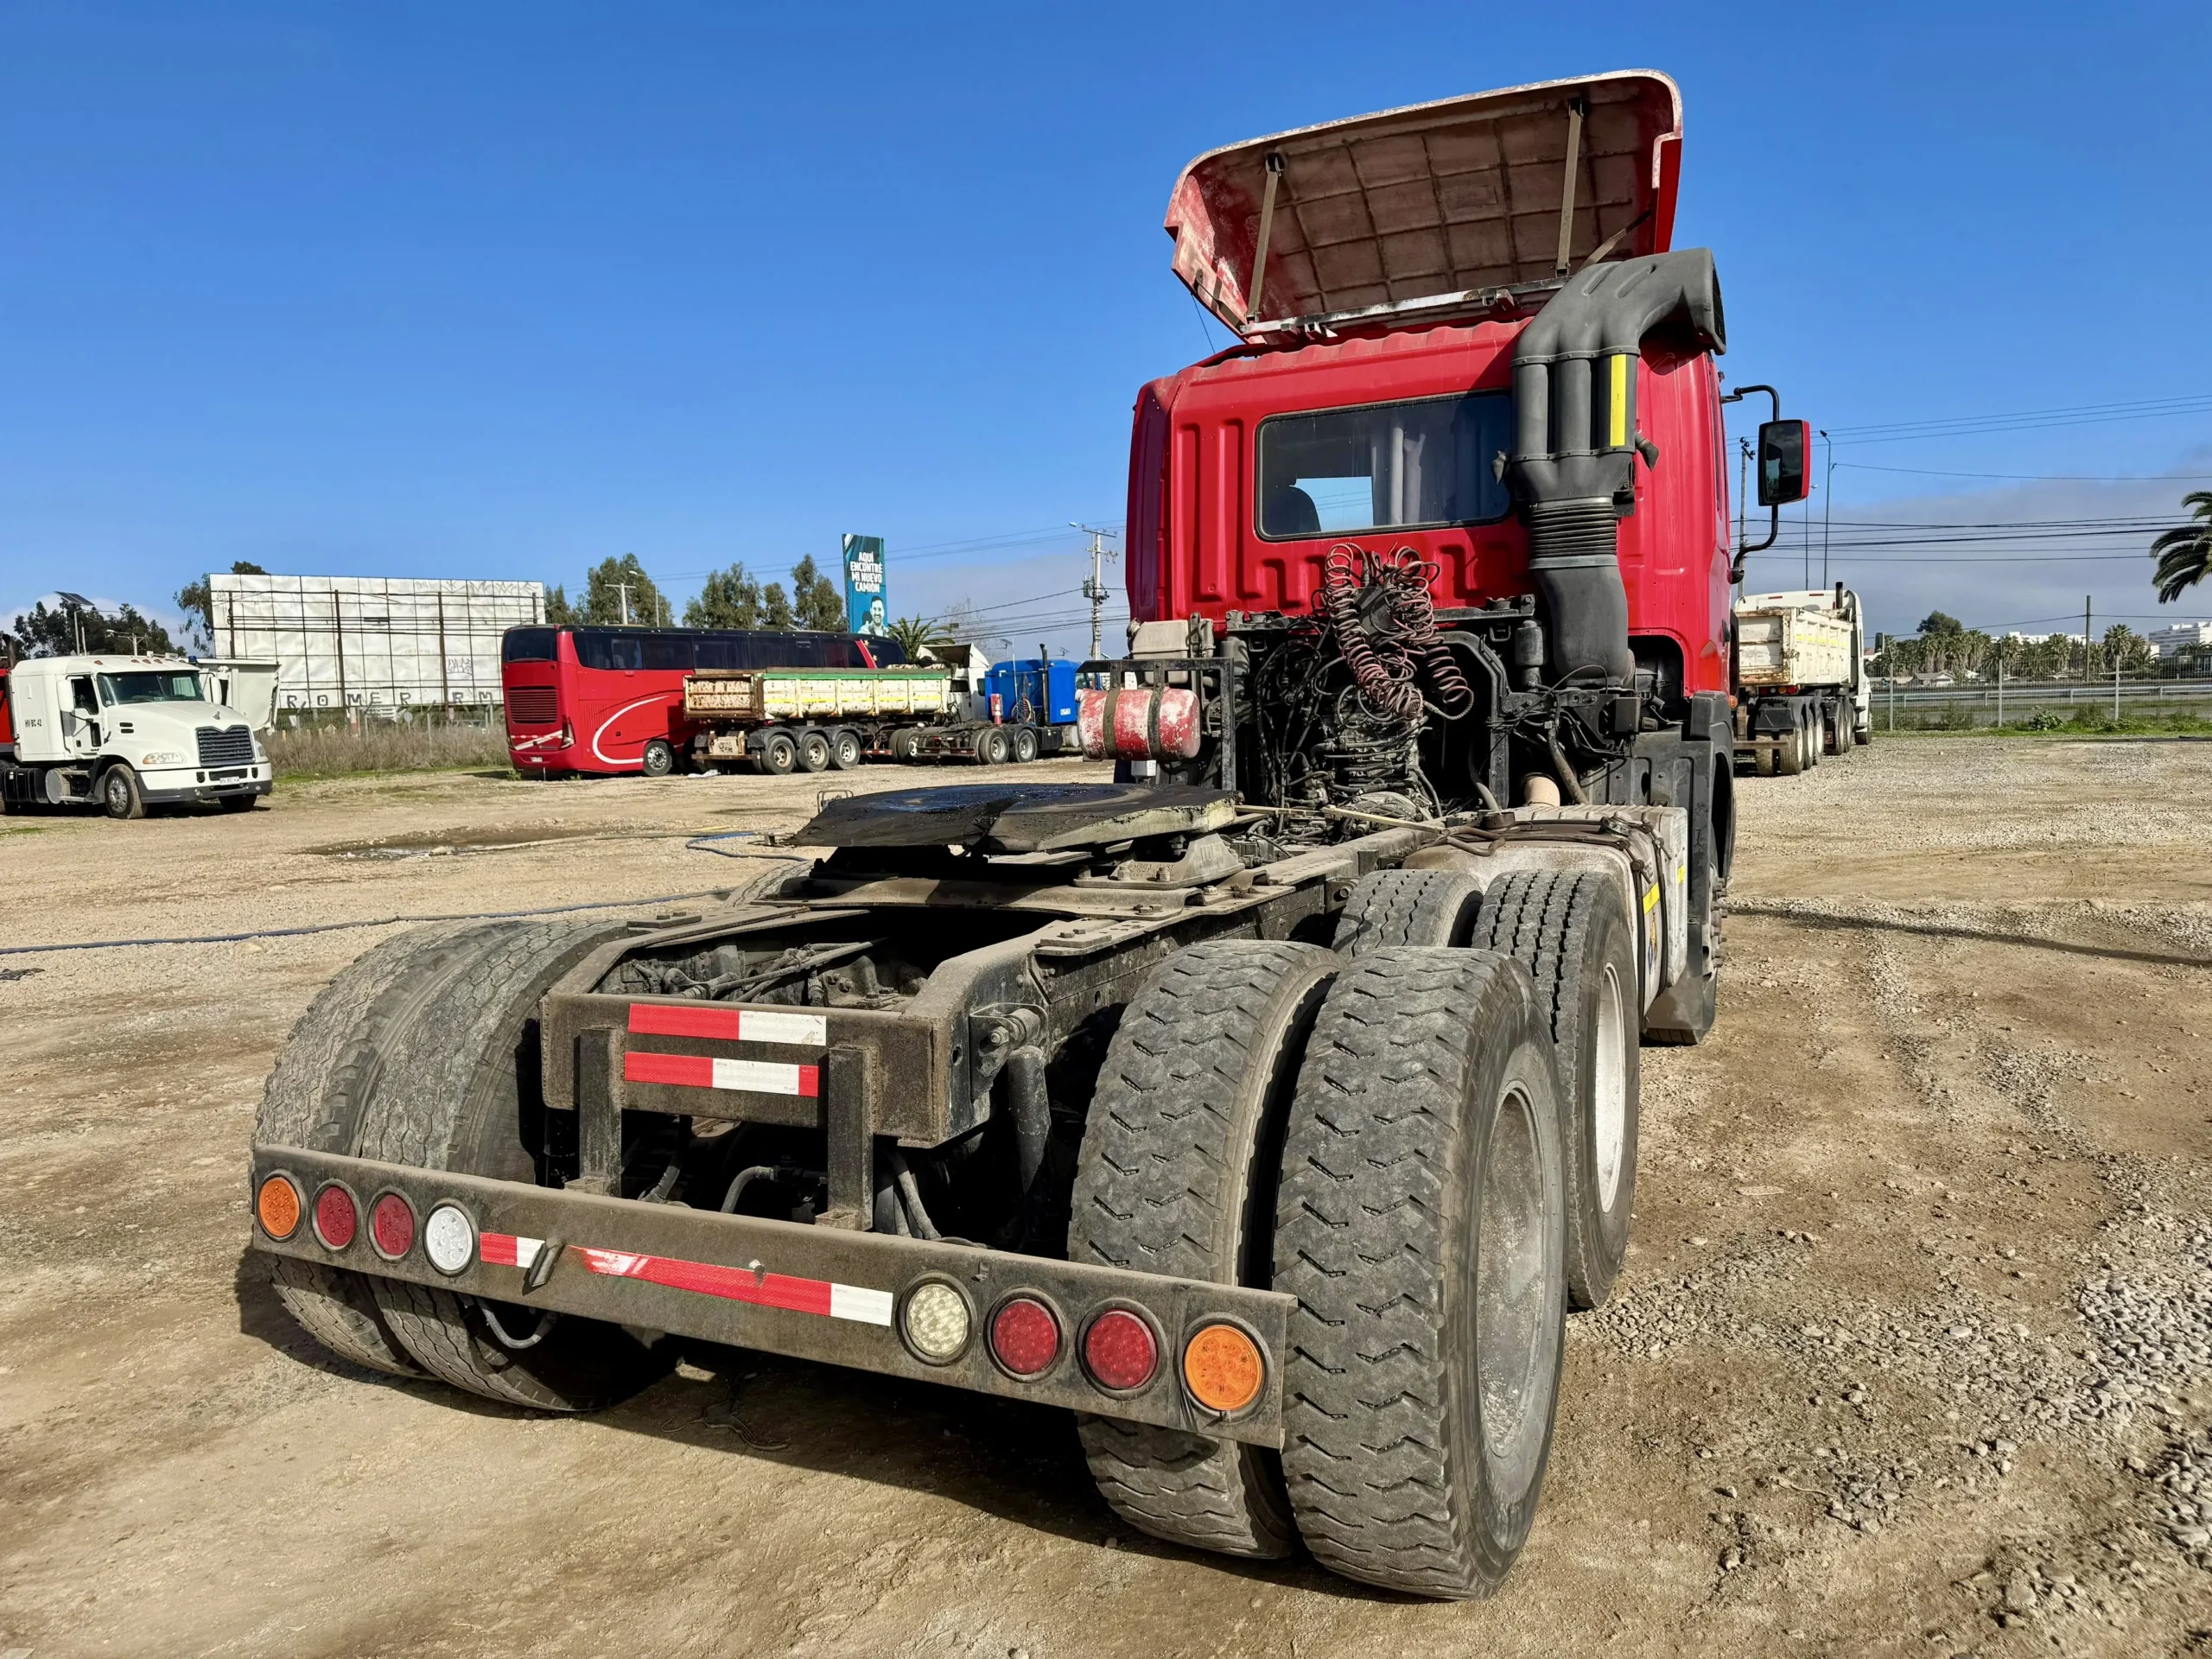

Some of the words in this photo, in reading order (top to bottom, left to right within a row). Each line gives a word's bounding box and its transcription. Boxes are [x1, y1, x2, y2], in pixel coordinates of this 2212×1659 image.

[858, 551, 874, 563] AQUÍ
[850, 562, 883, 573] ENCONTRÉ
[851, 571, 860, 582] MI
[861, 573, 882, 583] NUEVO
